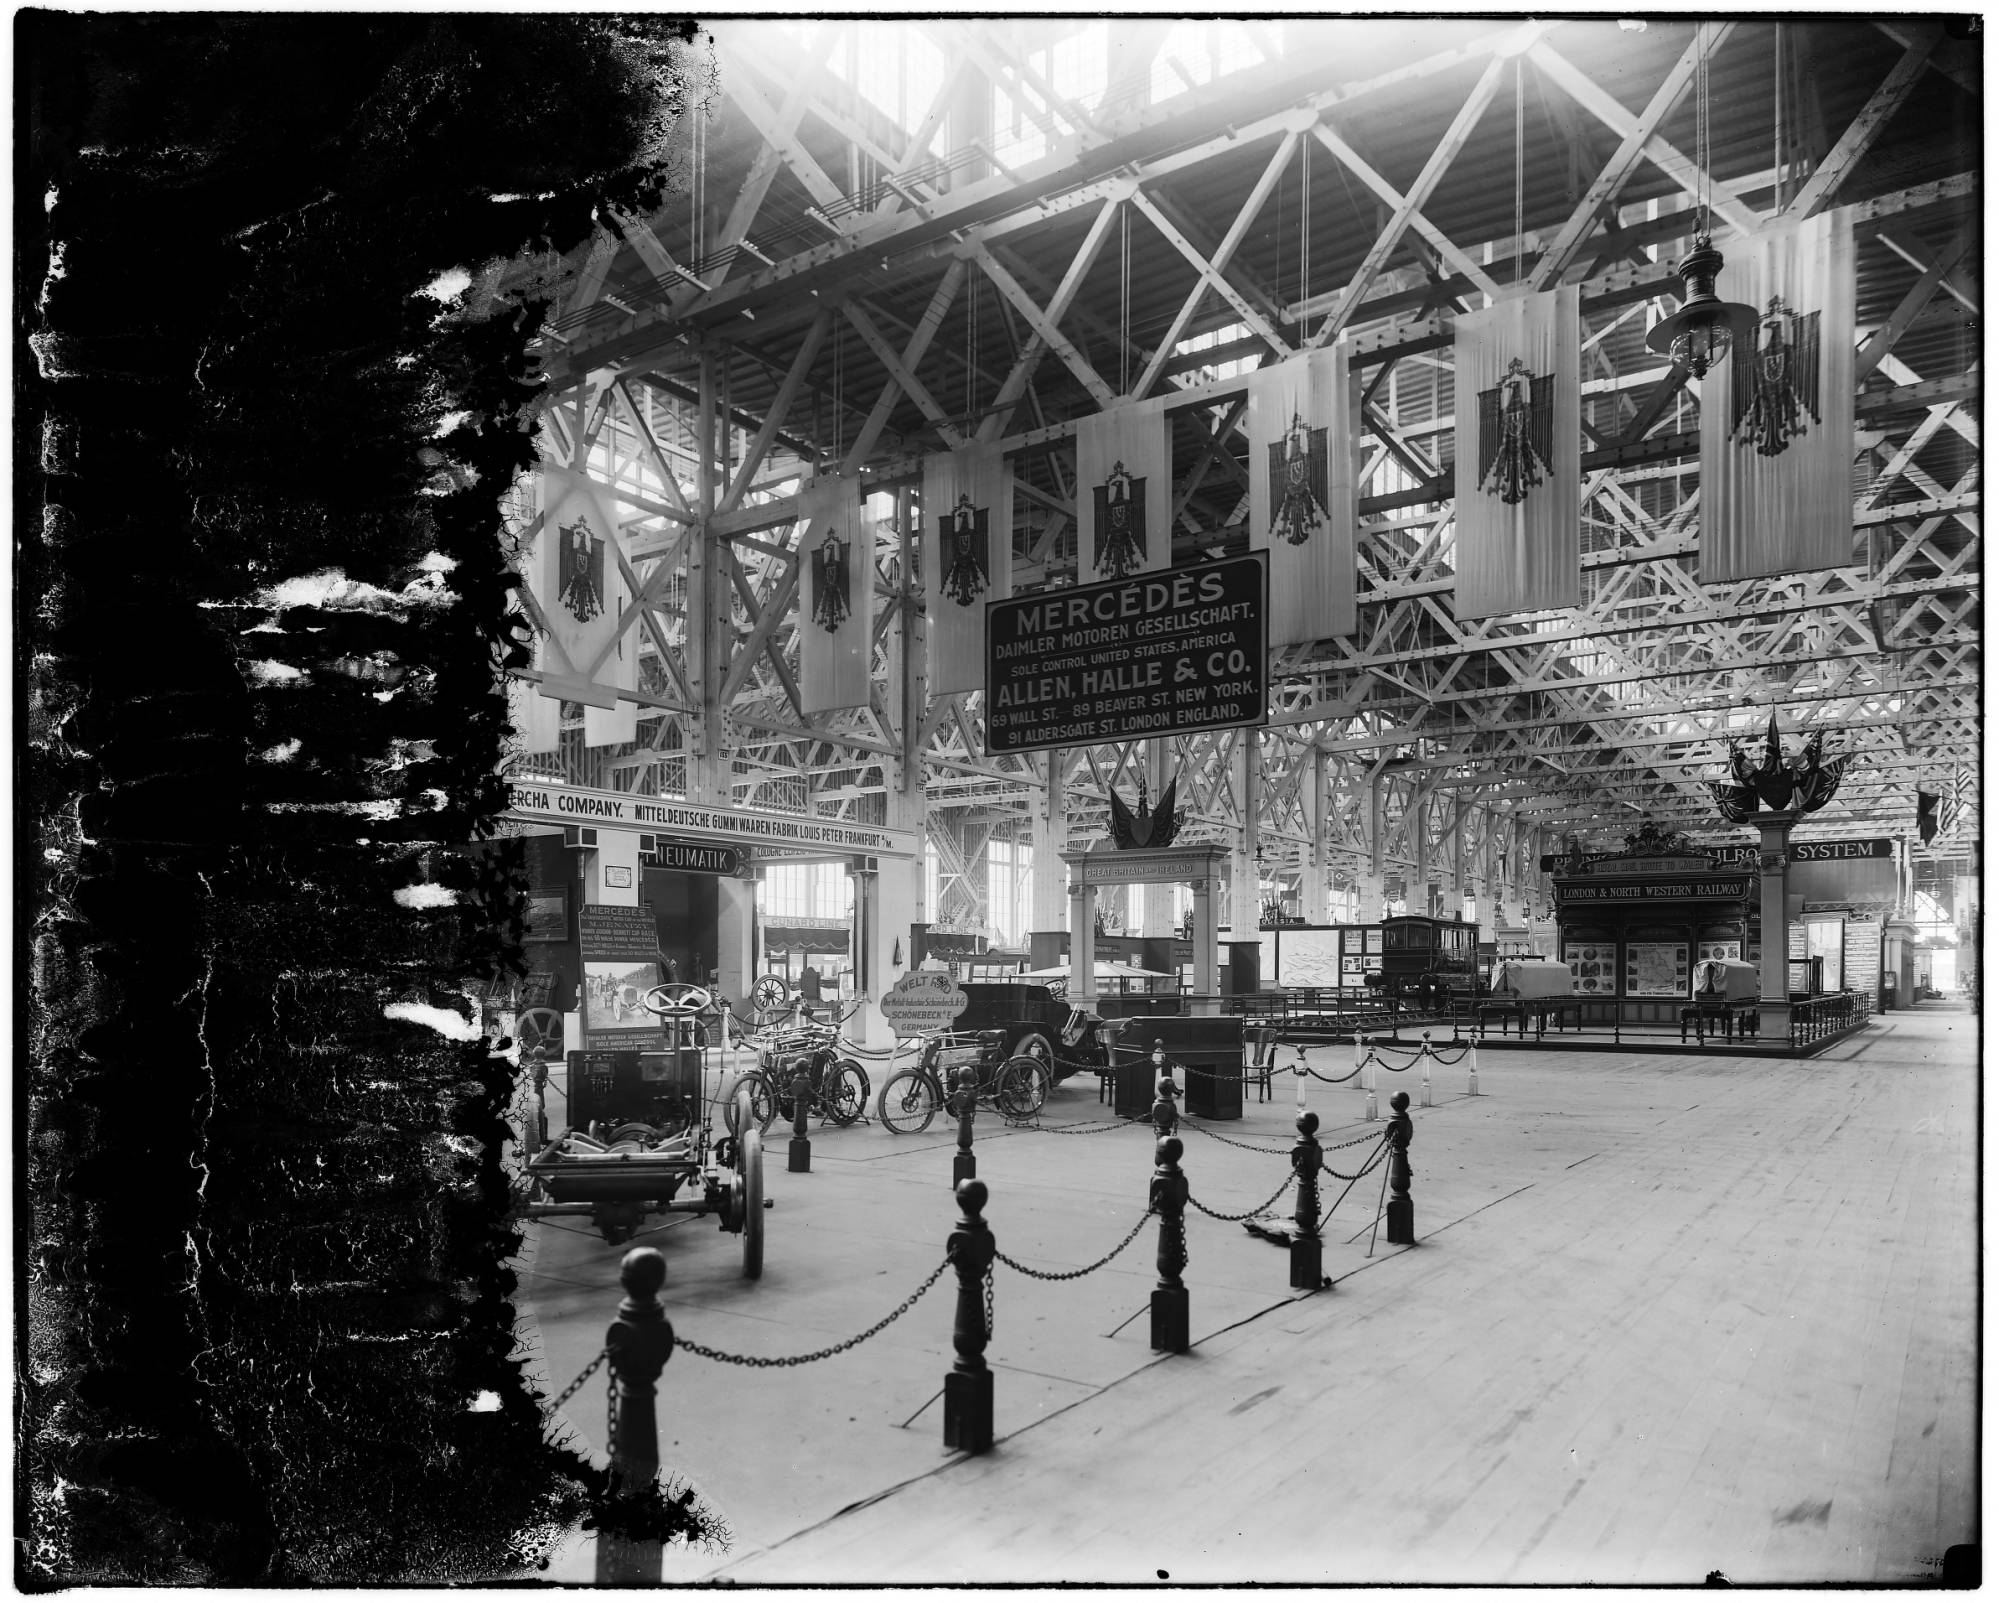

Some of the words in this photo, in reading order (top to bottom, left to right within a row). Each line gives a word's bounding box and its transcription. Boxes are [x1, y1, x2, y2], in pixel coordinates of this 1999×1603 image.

[1017, 572, 1225, 635] MERCÉDÈS
[996, 636, 1055, 659] DAIMLER
[1062, 624, 1129, 648] MOTOREN
[1136, 602, 1255, 636] GESELLSCHAFT.
[1011, 665, 1038, 677] SOLE
[1042, 657, 1087, 673] CONTROL
[1091, 650, 1129, 666] UNITED
[1181, 631, 1236, 651] AMERICA
[998, 675, 1076, 707] ALLEN,
[1082, 662, 1162, 695] HALLE
[1174, 658, 1198, 682] &
[1207, 650, 1251, 677] CO.
[991, 714, 1007, 728] 69
[1010, 710, 1038, 726] WALL
[1042, 708, 1059, 721] ST.
[1073, 704, 1090, 717] 89
[1096, 696, 1146, 714] BEAVER
[1151, 693, 1171, 706] ST.
[1176, 687, 1206, 704] NEW
[1213, 681, 1258, 699] YORK.
[1008, 732, 1021, 744] 91
[1025, 722, 1095, 743] ALDERSGATE
[1101, 720, 1117, 733] ST.
[1122, 714, 1170, 731] LONDON
[1177, 704, 1243, 723] ENGLAND.
[511, 790, 550, 809] ERCHA
[558, 795, 623, 818] COMPANY.
[635, 805, 710, 828] MITTELDEUTSCHE
[772, 822, 799, 838] FABRIK
[800, 825, 820, 841] LOUIS
[822, 828, 843, 843] PETER
[845, 831, 880, 848] FRANKFURT
[1087, 868, 1111, 877] GREAT
[1113, 866, 1144, 876] BRITAIN
[1157, 864, 1192, 874] IRELAND
[1797, 842, 1874, 859] SYSTEM
[1563, 888, 1596, 899] LONDON
[1600, 888, 1607, 898] &
[1610, 887, 1640, 897] NORTH
[1645, 886, 1692, 897] WESTERN
[1697, 884, 1741, 895] RAILWAY
[772, 919, 816, 928] CUNARD
[818, 920, 841, 929] LINE
[899, 976, 928, 993] WELT
